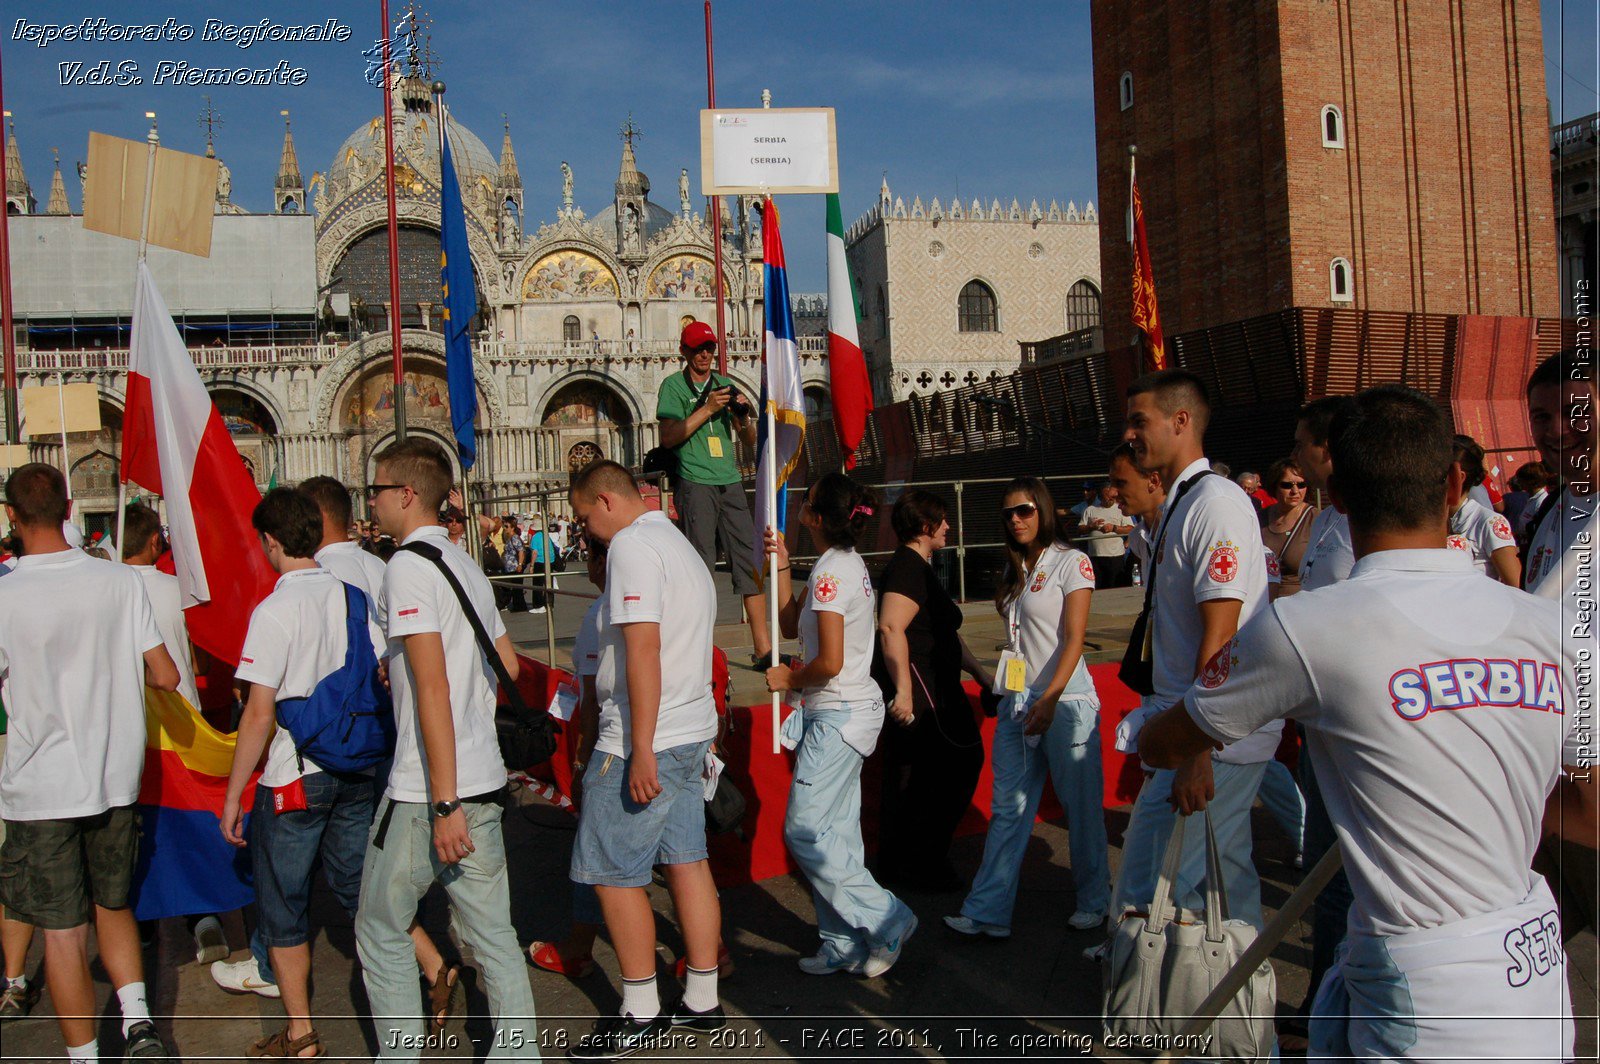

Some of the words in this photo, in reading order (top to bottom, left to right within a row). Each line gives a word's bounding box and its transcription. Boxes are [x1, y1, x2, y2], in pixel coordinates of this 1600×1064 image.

[753, 136, 787, 144] SERBIA
[750, 157, 792, 165] (SERBIA)
[1389, 658, 1565, 721] SERBIA
